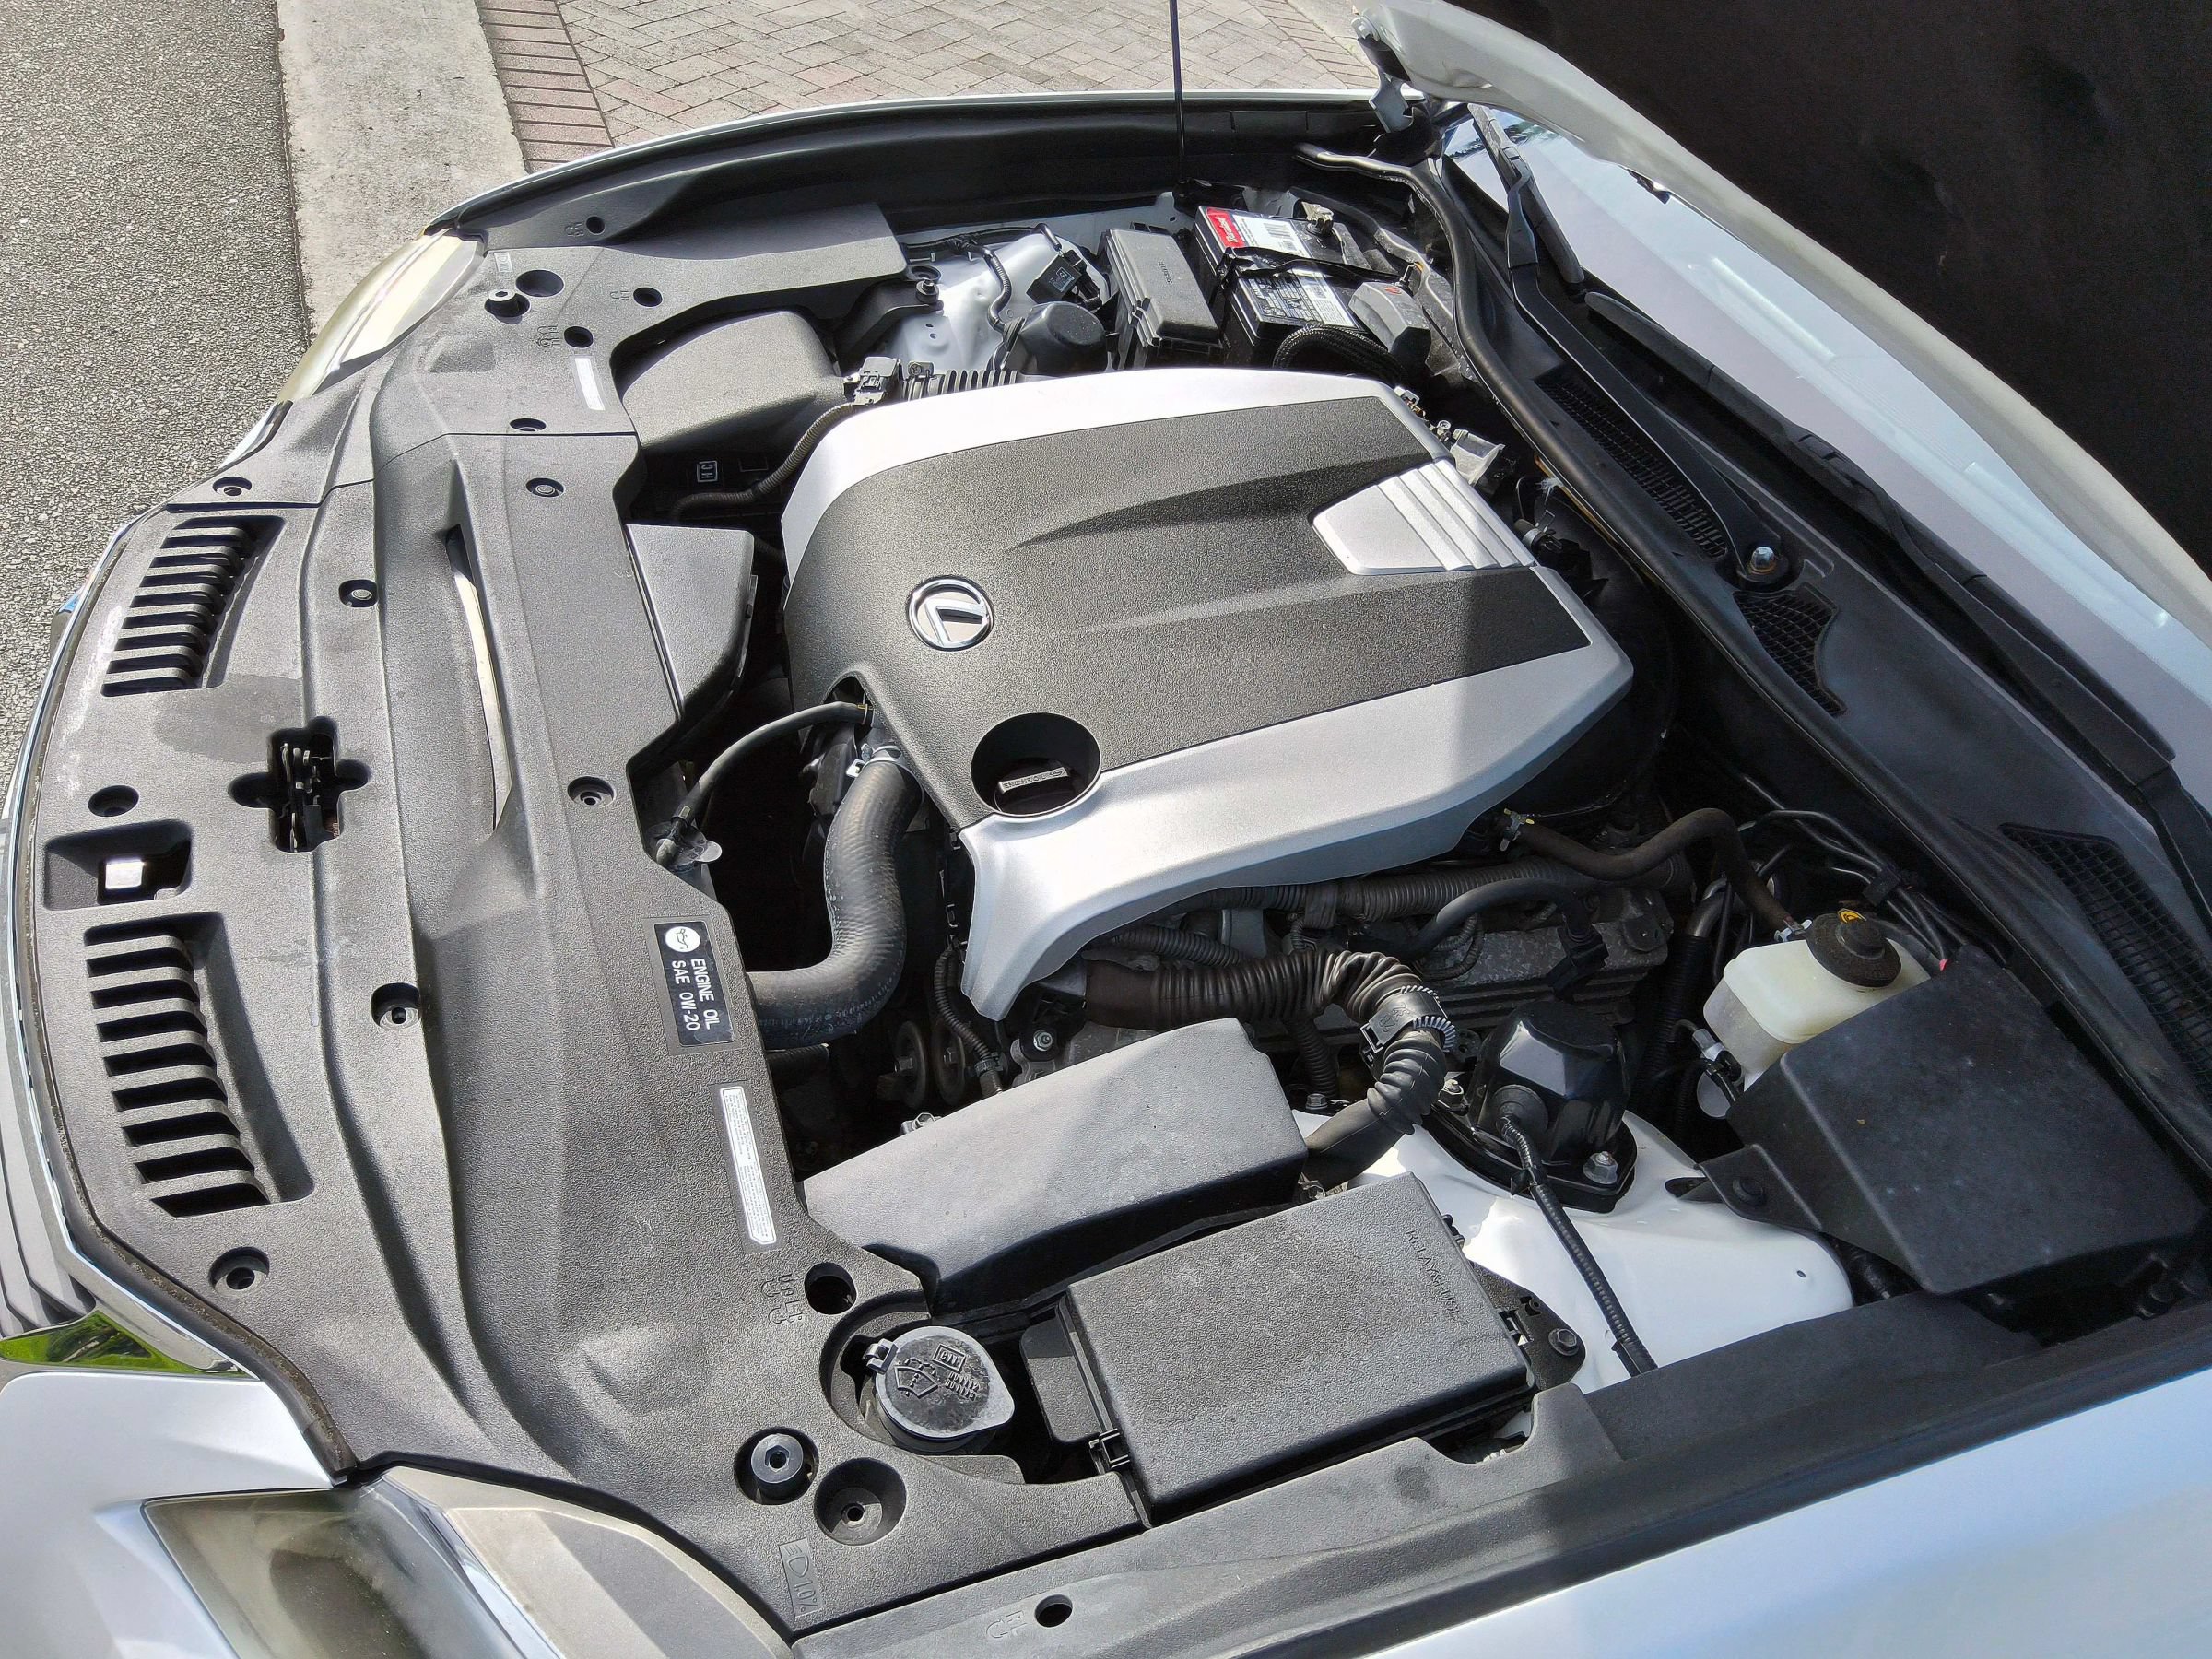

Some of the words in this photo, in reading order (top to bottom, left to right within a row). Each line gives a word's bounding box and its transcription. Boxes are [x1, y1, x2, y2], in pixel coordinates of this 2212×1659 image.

[672, 960, 690, 985] SAE
[679, 992, 701, 1030] 0W-20
[690, 958, 715, 1002] ENGINE
[703, 1008, 721, 1030] OIL
